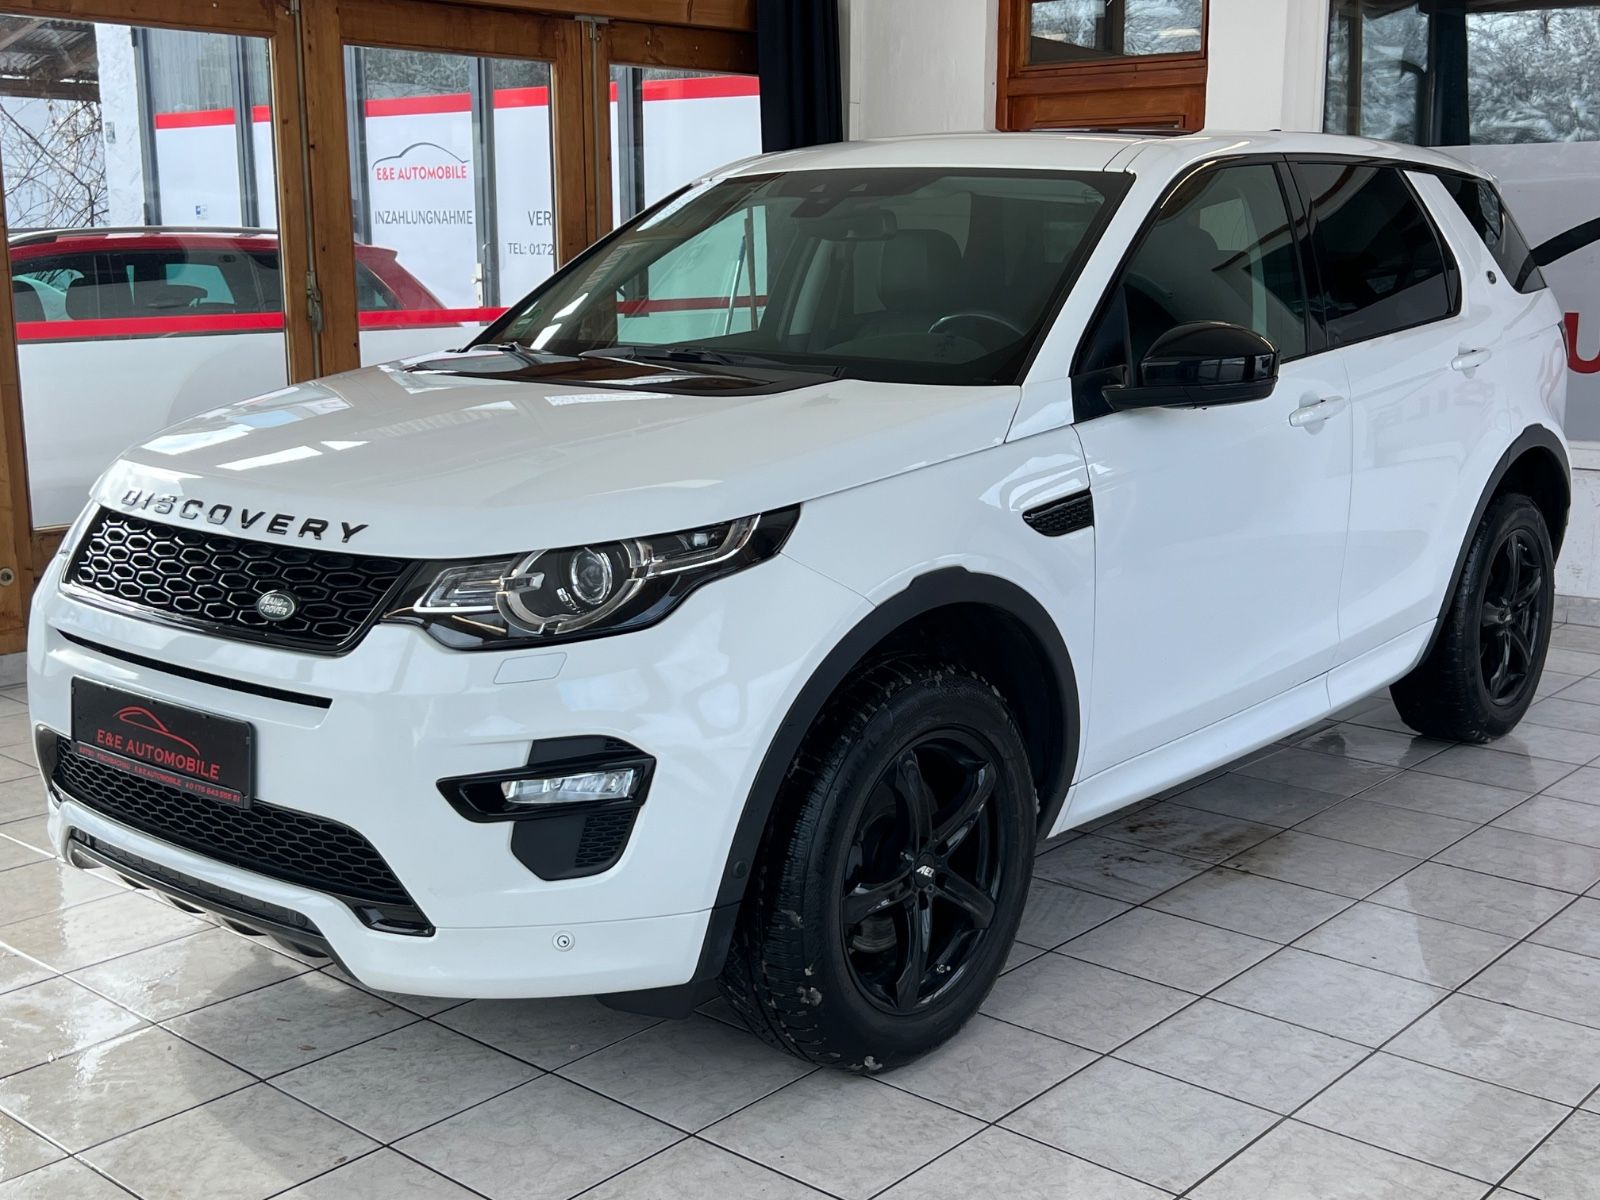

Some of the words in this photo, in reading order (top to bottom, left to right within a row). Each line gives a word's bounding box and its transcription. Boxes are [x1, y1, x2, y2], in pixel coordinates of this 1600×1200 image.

[376, 167, 395, 181] E&E
[399, 165, 467, 180] AUTOMOBILE
[375, 210, 473, 225] INZAHLUNGNAHME
[528, 210, 552, 226] VER
[507, 242, 527, 255] TEL:
[121, 489, 369, 544] DISCOVERY
[264, 604, 288, 616] ROVER
[97, 729, 122, 750] E&E
[126, 739, 220, 780] AUTOMOBILE
